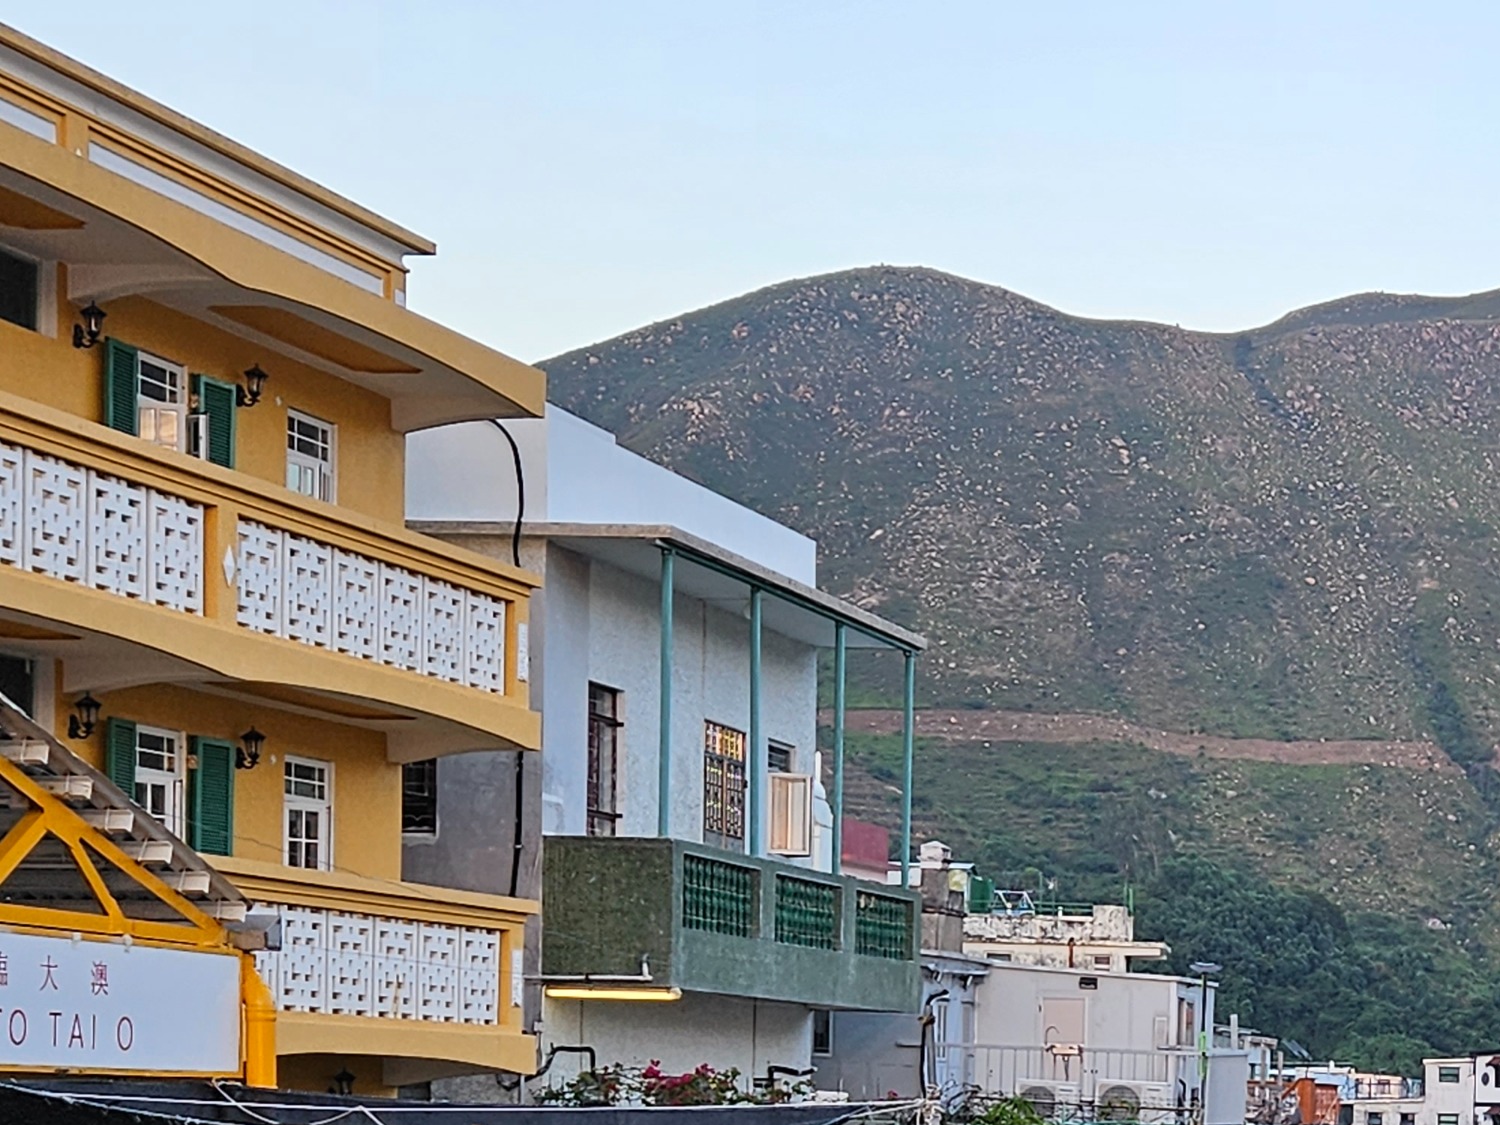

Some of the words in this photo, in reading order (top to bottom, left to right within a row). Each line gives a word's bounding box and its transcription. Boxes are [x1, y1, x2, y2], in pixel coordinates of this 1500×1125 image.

[0, 1008, 27, 1047] O
[49, 1011, 97, 1051] TAI
[117, 1016, 134, 1052] O
